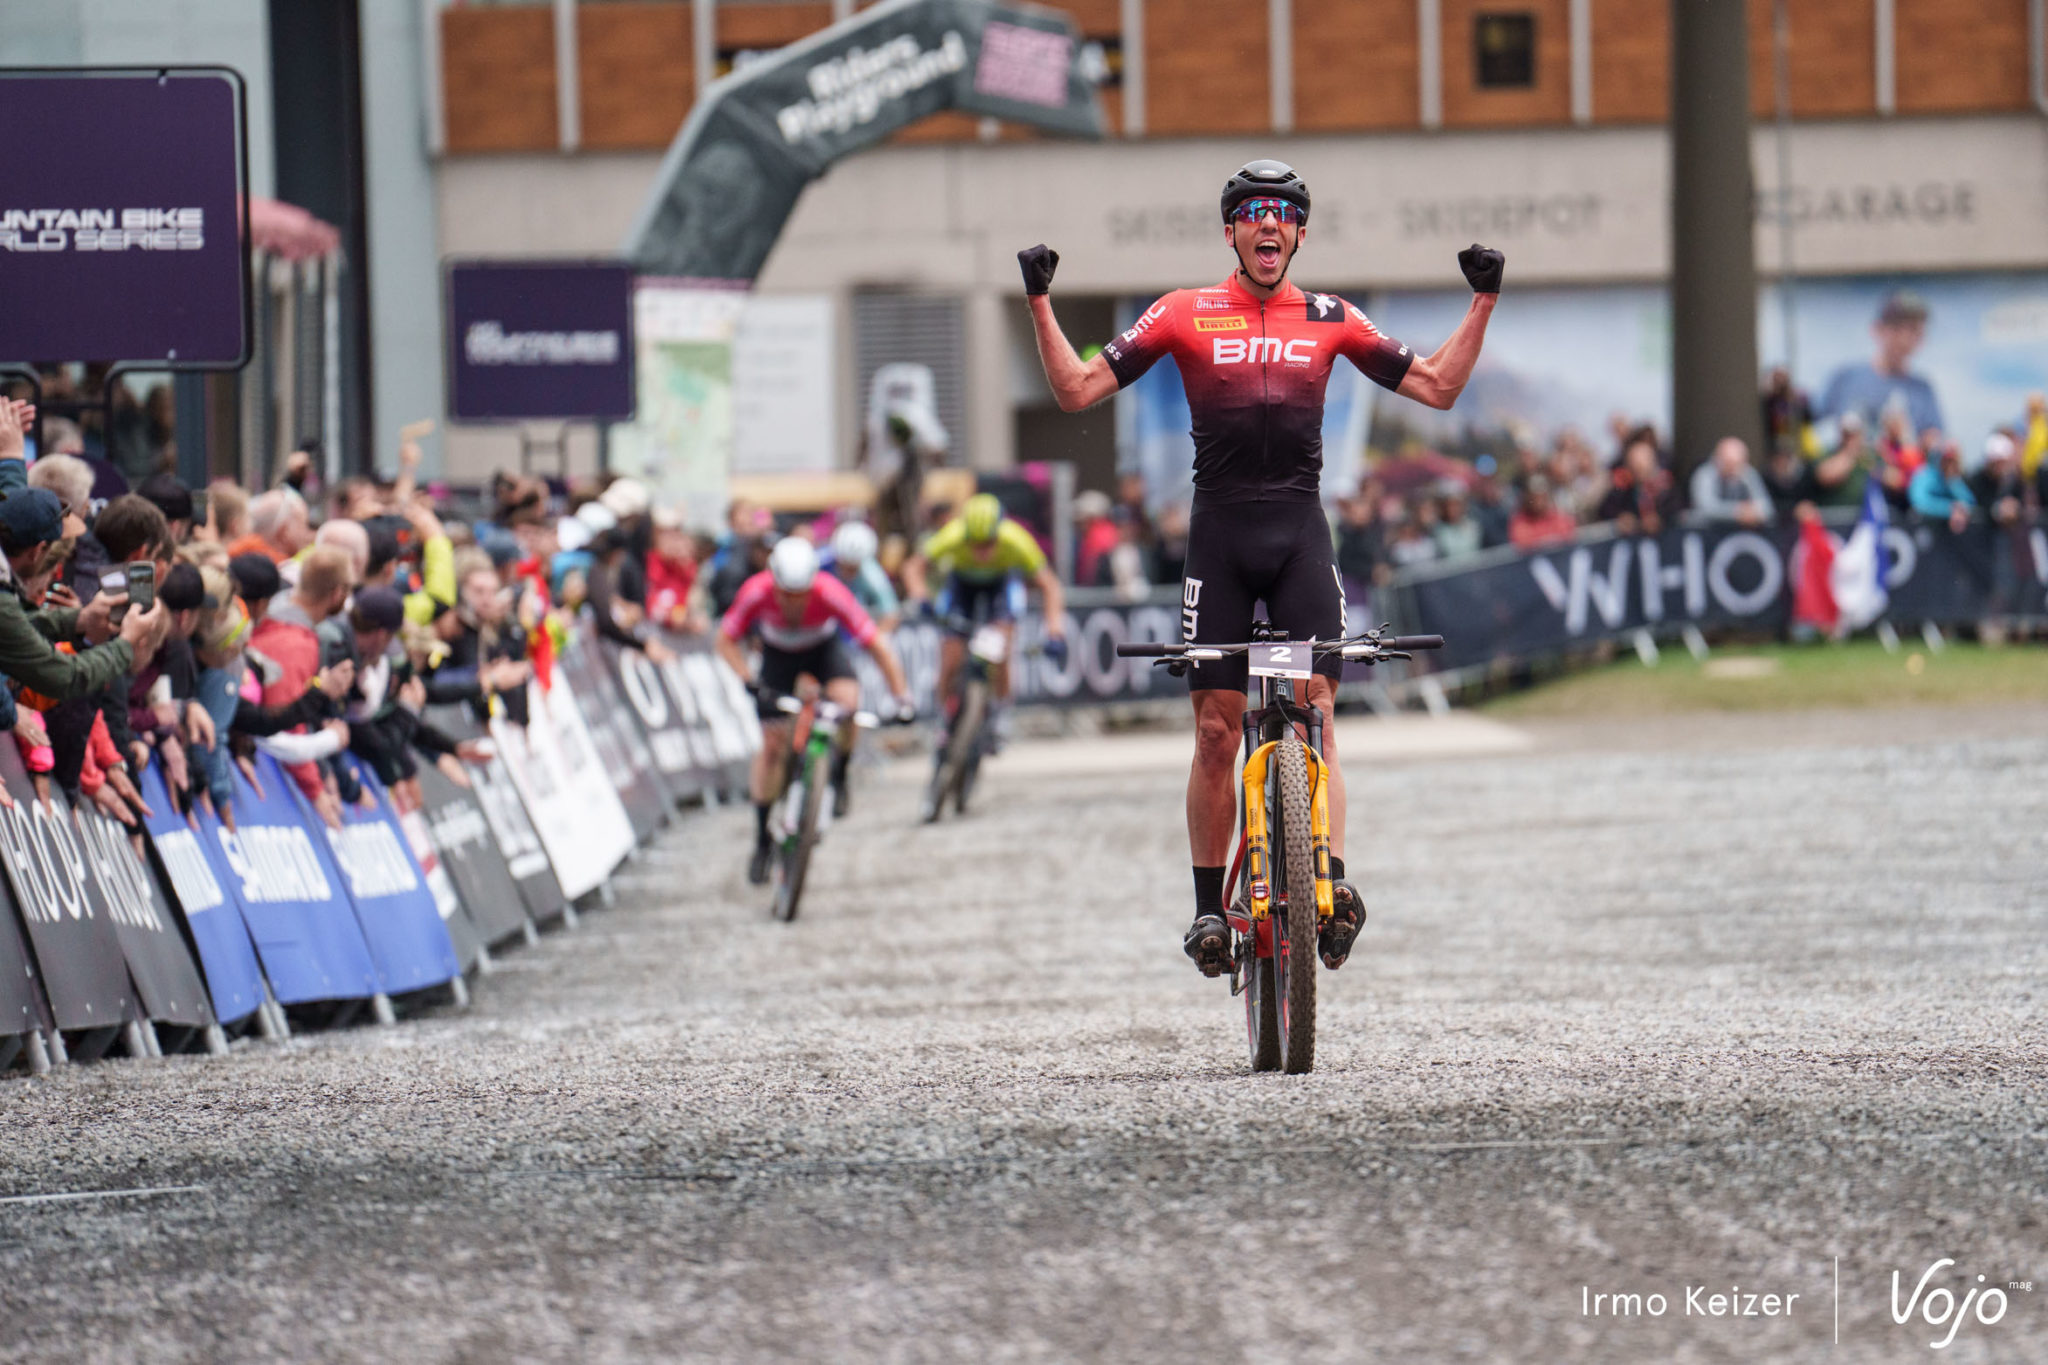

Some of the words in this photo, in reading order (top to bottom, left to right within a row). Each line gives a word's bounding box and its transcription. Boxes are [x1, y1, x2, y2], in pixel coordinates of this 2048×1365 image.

[806, 32, 922, 101] Riders
[776, 29, 968, 146] Playground
[121, 208, 204, 229] BIKE
[0, 229, 67, 252] RLD
[74, 228, 205, 251] SERIES
[1198, 318, 1242, 329] PIRELLI
[1213, 336, 1318, 365] BMC
[1269, 646, 1293, 663] 2
